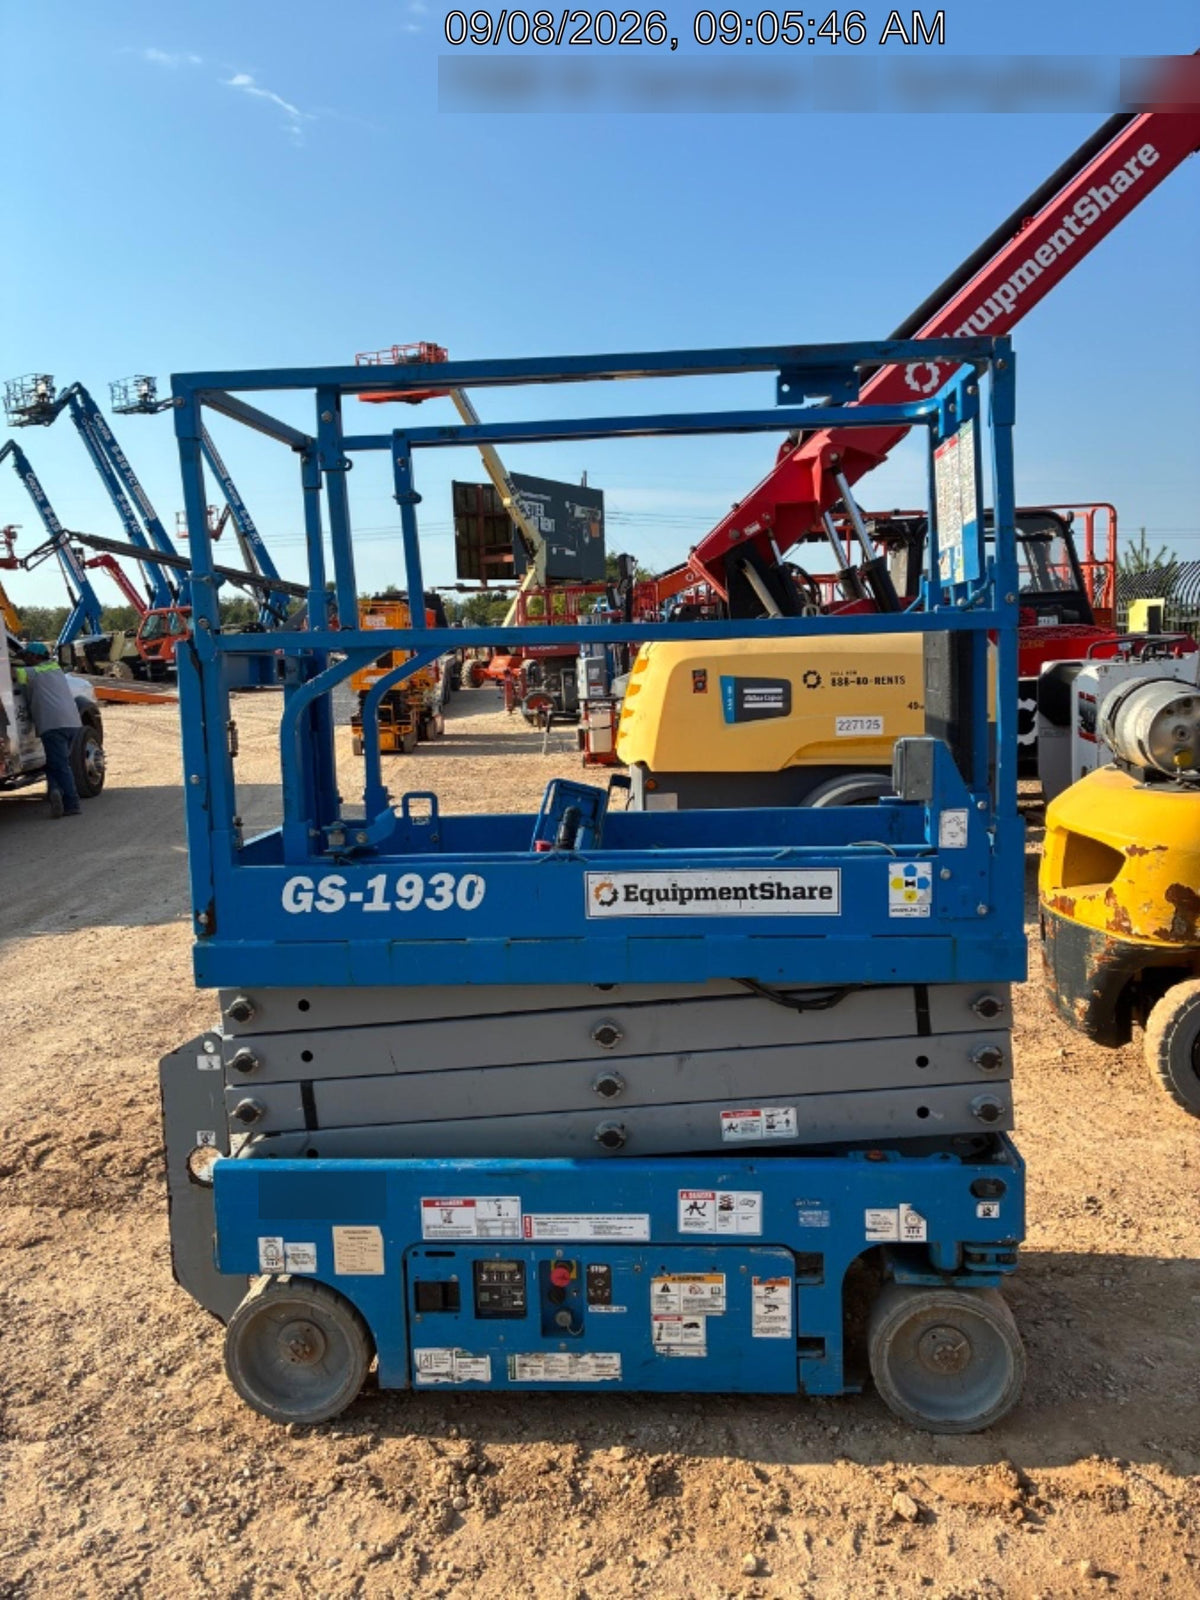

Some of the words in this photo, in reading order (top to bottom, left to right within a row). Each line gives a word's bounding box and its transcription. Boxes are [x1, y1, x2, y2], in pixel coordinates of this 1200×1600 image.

[941, 140, 1160, 338] quipmentShare
[281, 872, 486, 914] GS-1930
[623, 882, 833, 906] EquipmentShare
